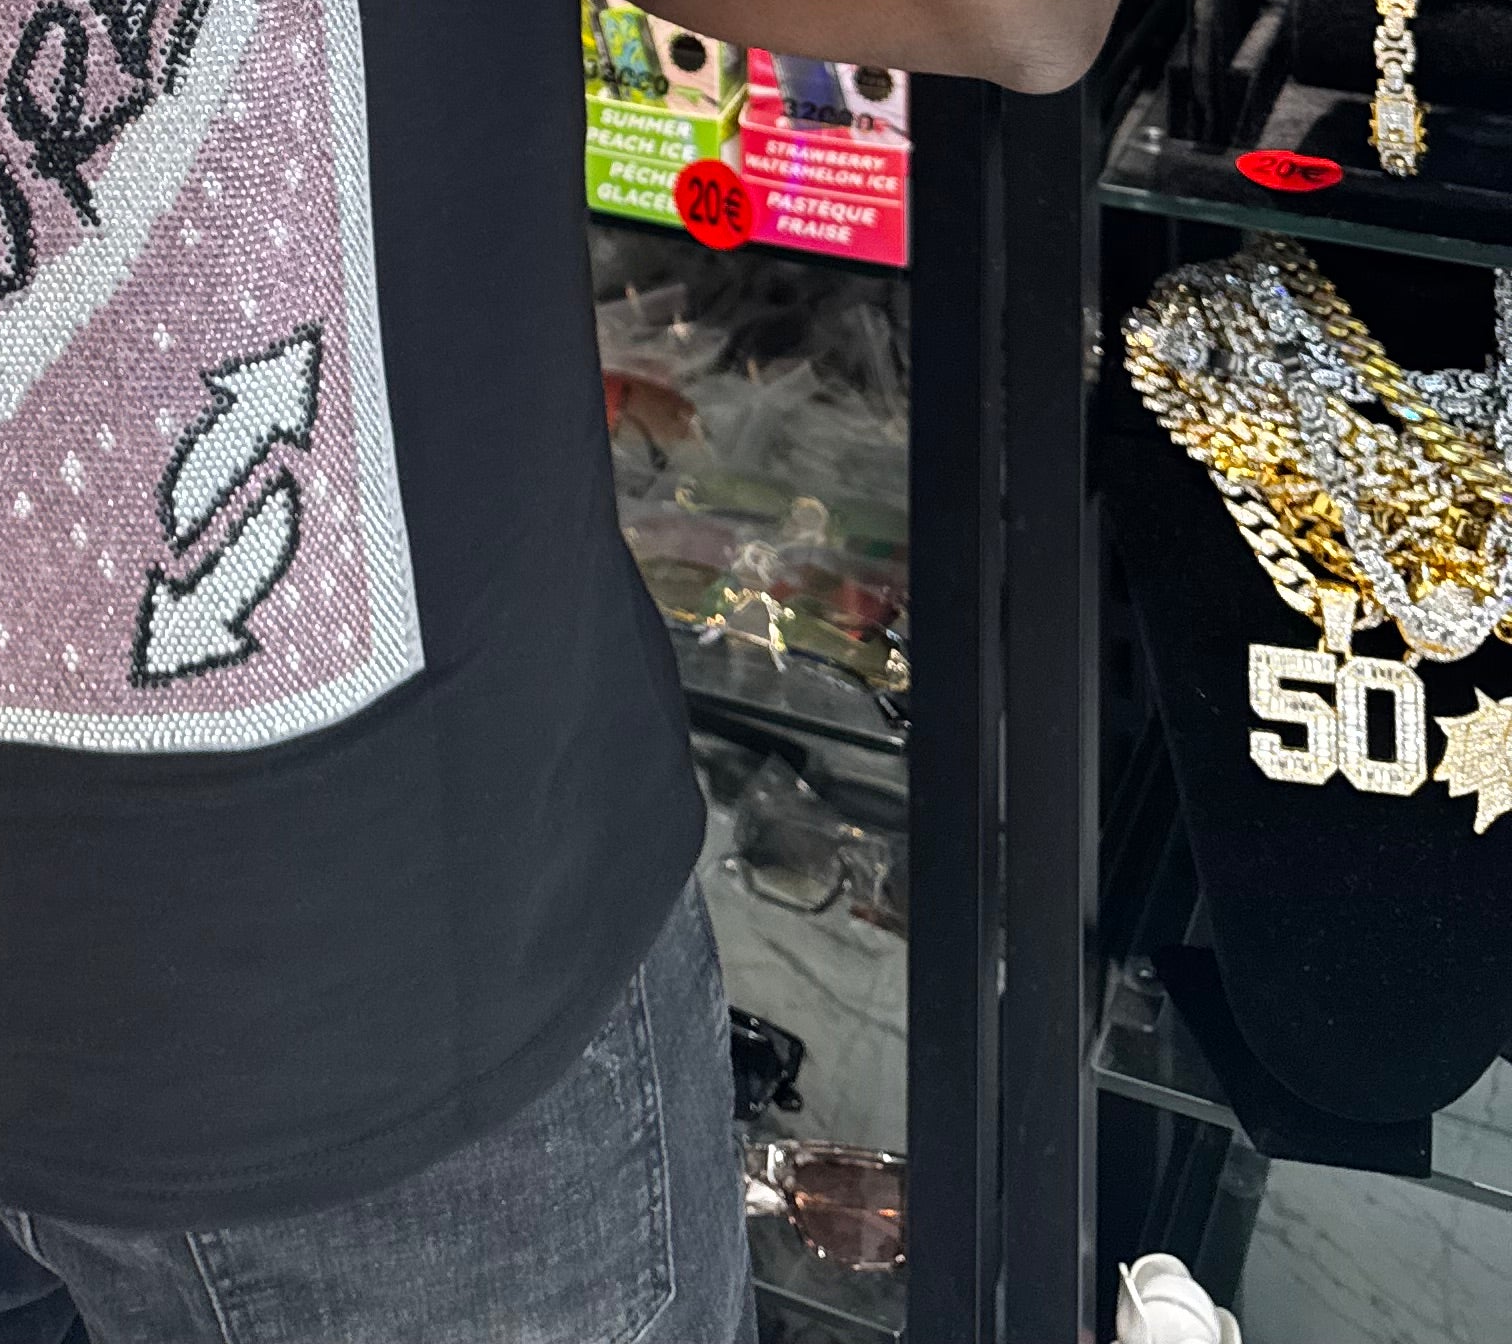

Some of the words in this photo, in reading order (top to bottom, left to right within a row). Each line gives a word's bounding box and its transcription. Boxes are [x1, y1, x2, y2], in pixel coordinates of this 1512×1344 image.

[600, 108, 693, 139] SUMMER
[586, 126, 655, 154] PEACH
[660, 141, 697, 162] ICE
[765, 140, 887, 170] STRAWBERRY
[745, 153, 863, 187] WATERMELON
[867, 175, 899, 193] ICE
[689, 178, 743, 233] 20€
[776, 215, 854, 245] FRAISE
[1248, 643, 1427, 797] 50
